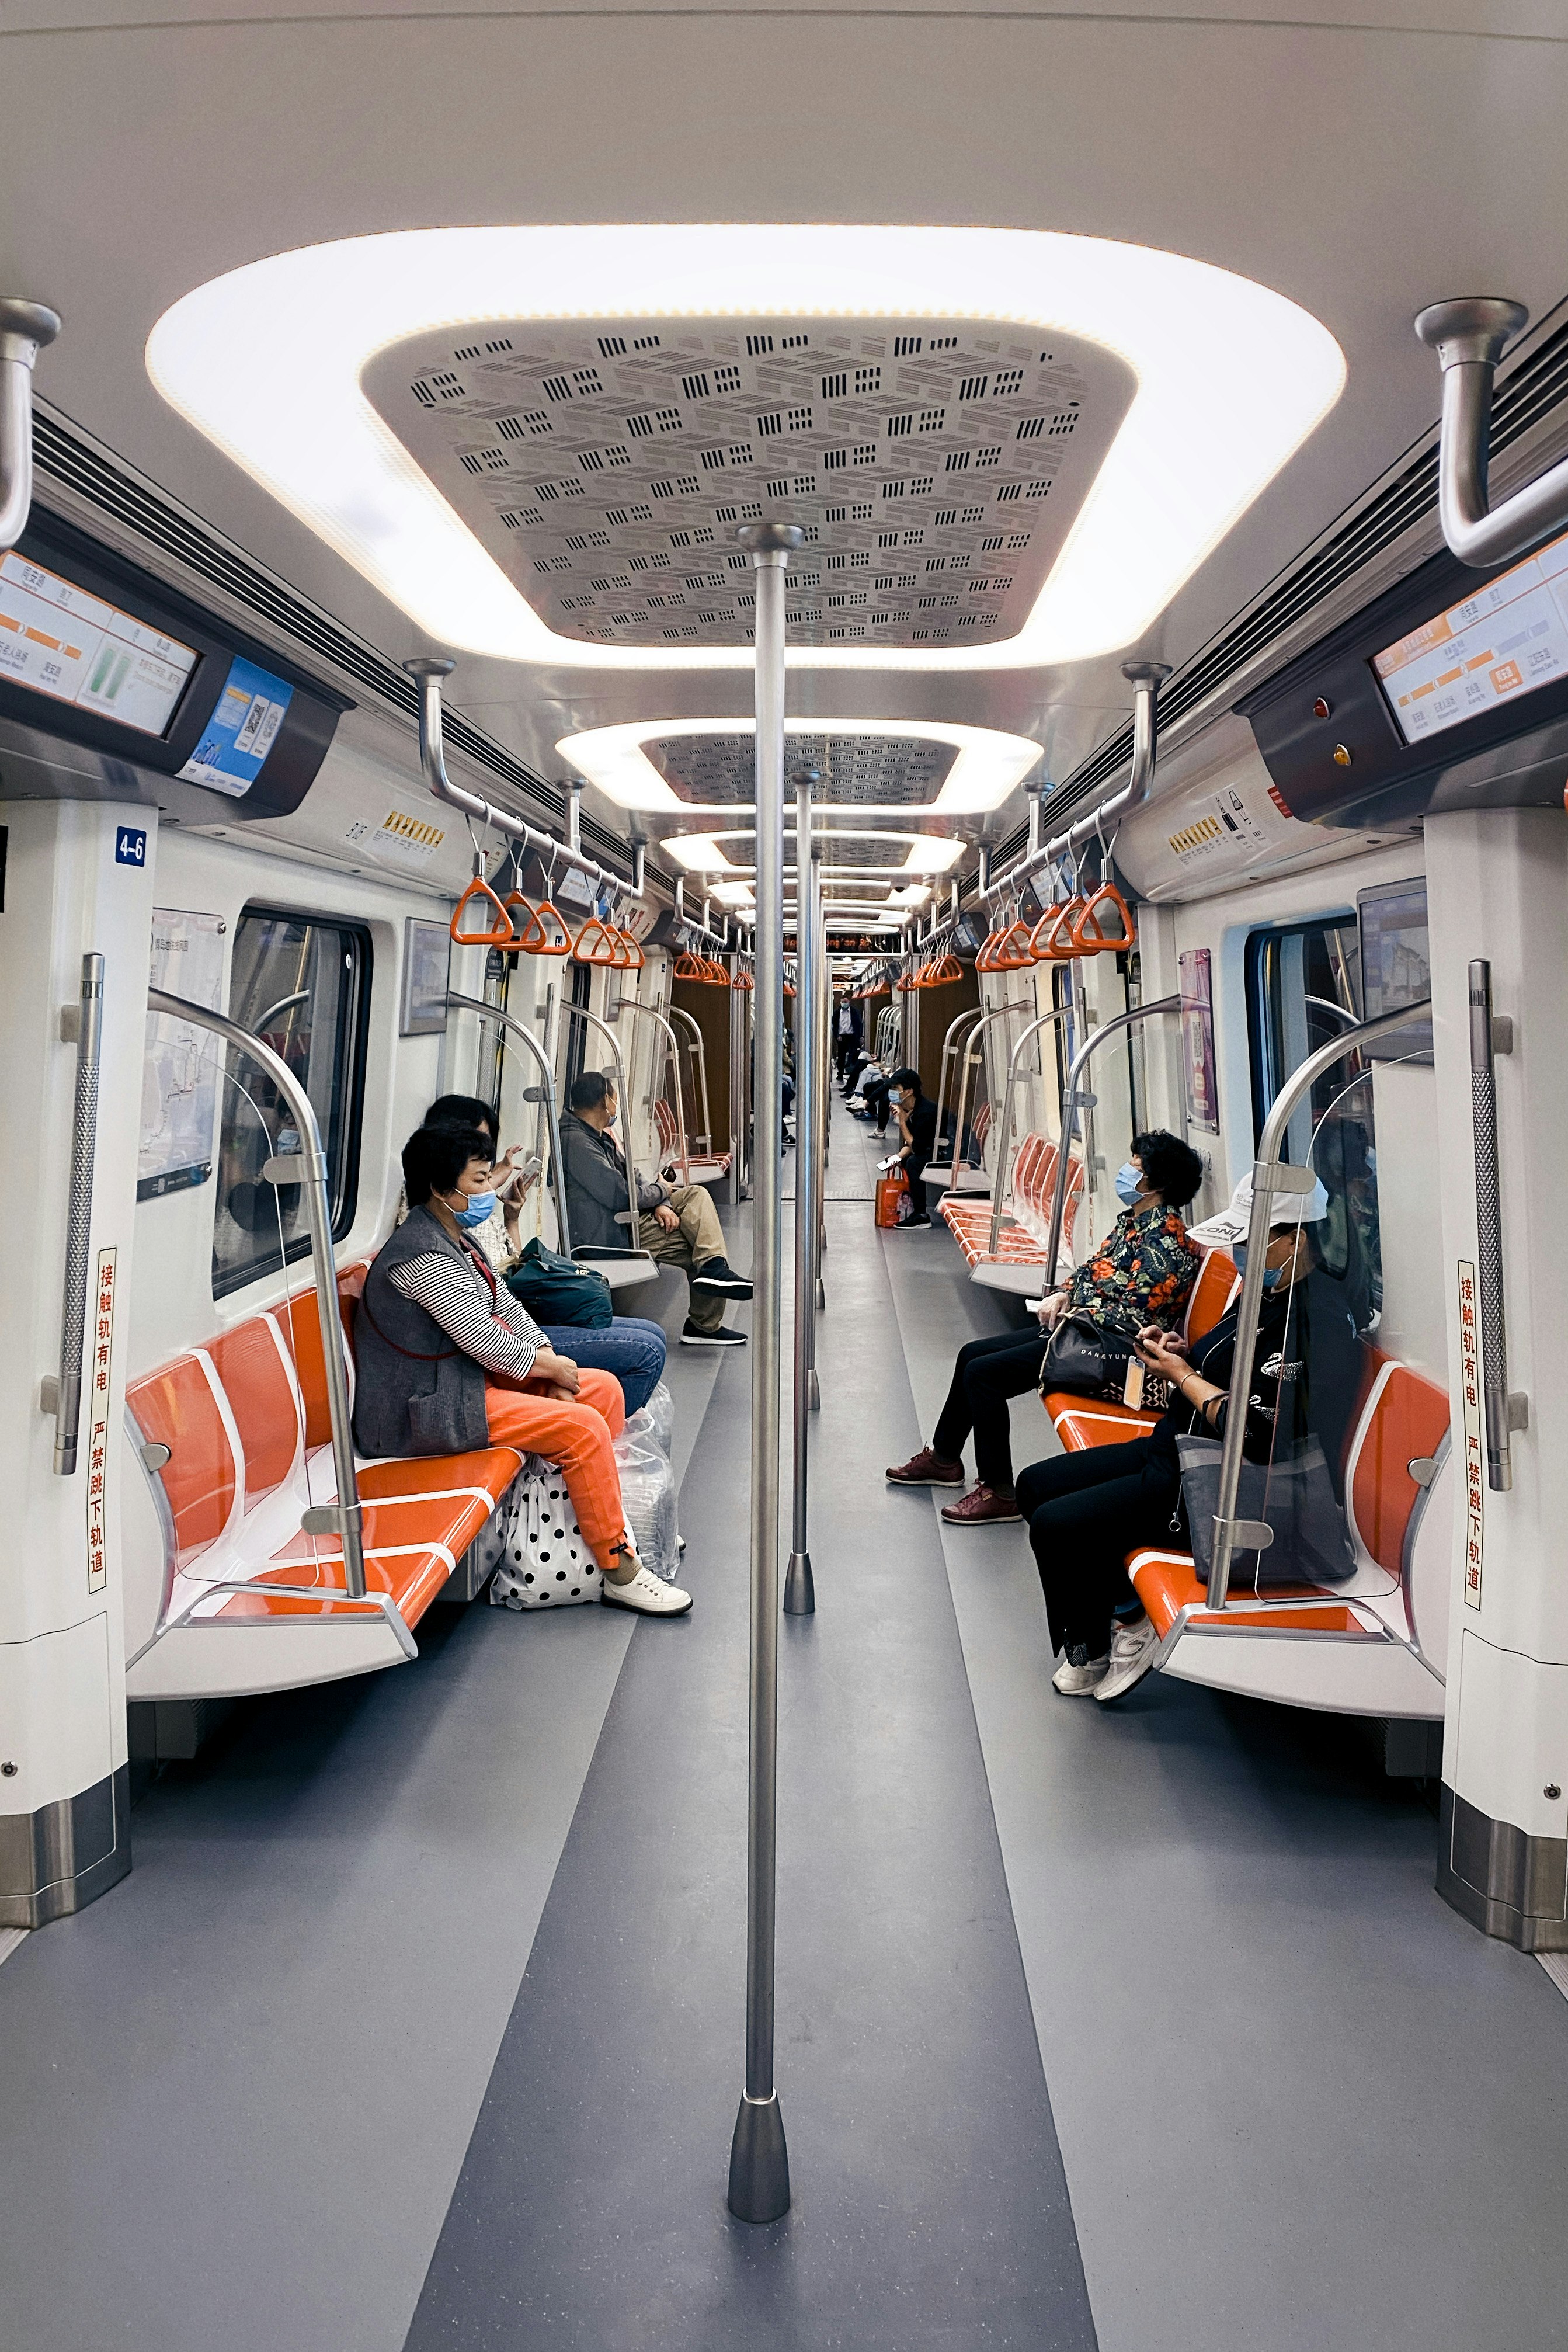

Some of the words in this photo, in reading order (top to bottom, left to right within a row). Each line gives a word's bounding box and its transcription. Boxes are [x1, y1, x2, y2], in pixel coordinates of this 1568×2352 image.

[120, 834, 143, 860] 4-6
[96, 1264, 113, 1391] 接触轨有电
[1461, 1277, 1476, 1406] 接触轨有电
[90, 1421, 105, 1573] 严禁跳下轨道
[1468, 1436, 1481, 1590] 严禁跳下轨道
